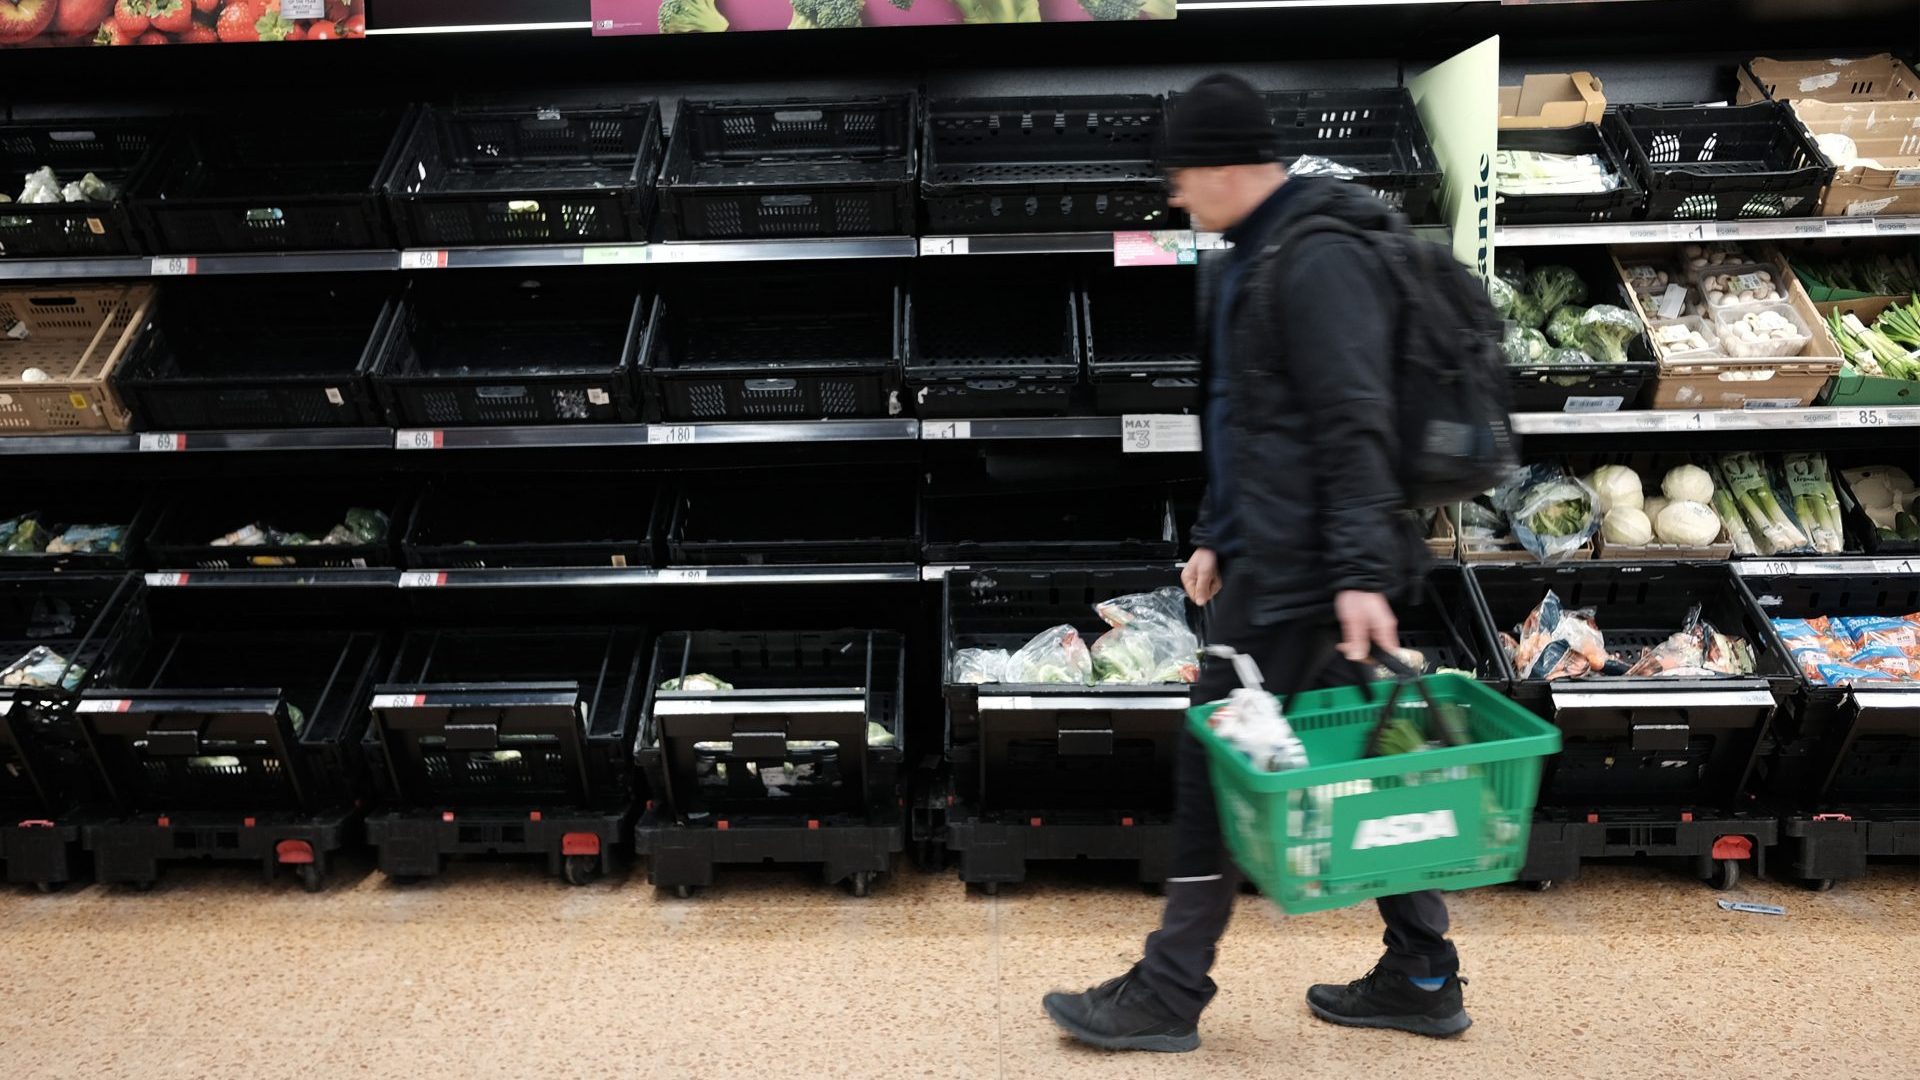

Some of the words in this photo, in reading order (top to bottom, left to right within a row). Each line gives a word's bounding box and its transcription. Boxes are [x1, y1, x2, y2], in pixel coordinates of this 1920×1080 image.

[1125, 420, 1150, 429] MAX
[1858, 410, 1884, 425] 85p
[1350, 809, 1459, 850] ASDA
